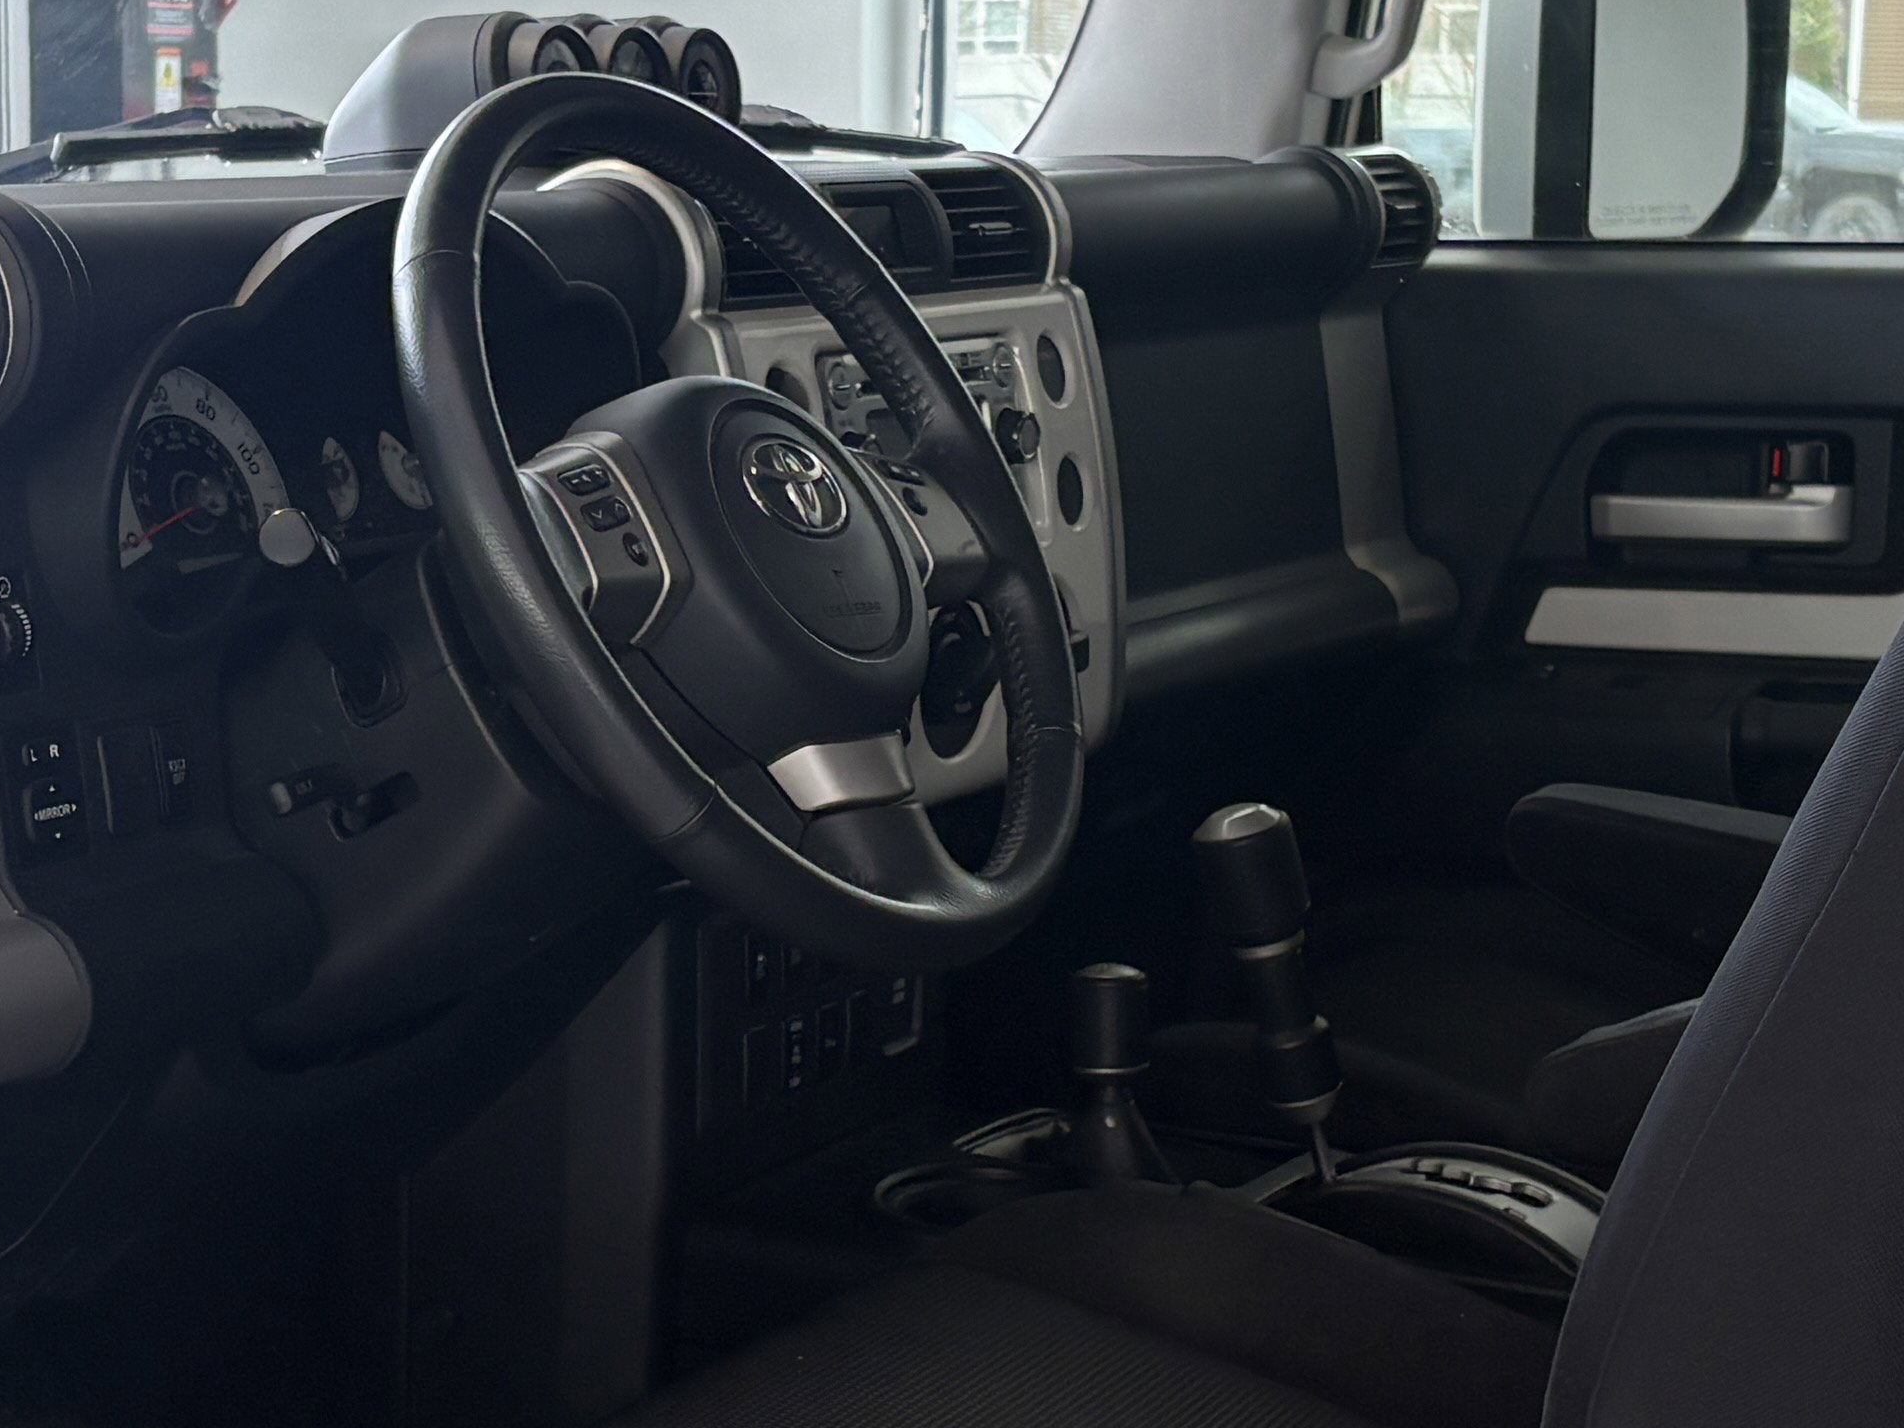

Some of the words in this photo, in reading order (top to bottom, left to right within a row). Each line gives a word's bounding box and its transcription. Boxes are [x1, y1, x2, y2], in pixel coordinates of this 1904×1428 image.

[196, 398, 216, 422] 80
[237, 442, 260, 475] 100
[30, 748, 38, 762] L
[49, 743, 60, 758] R
[38, 803, 71, 820] MIRROR
